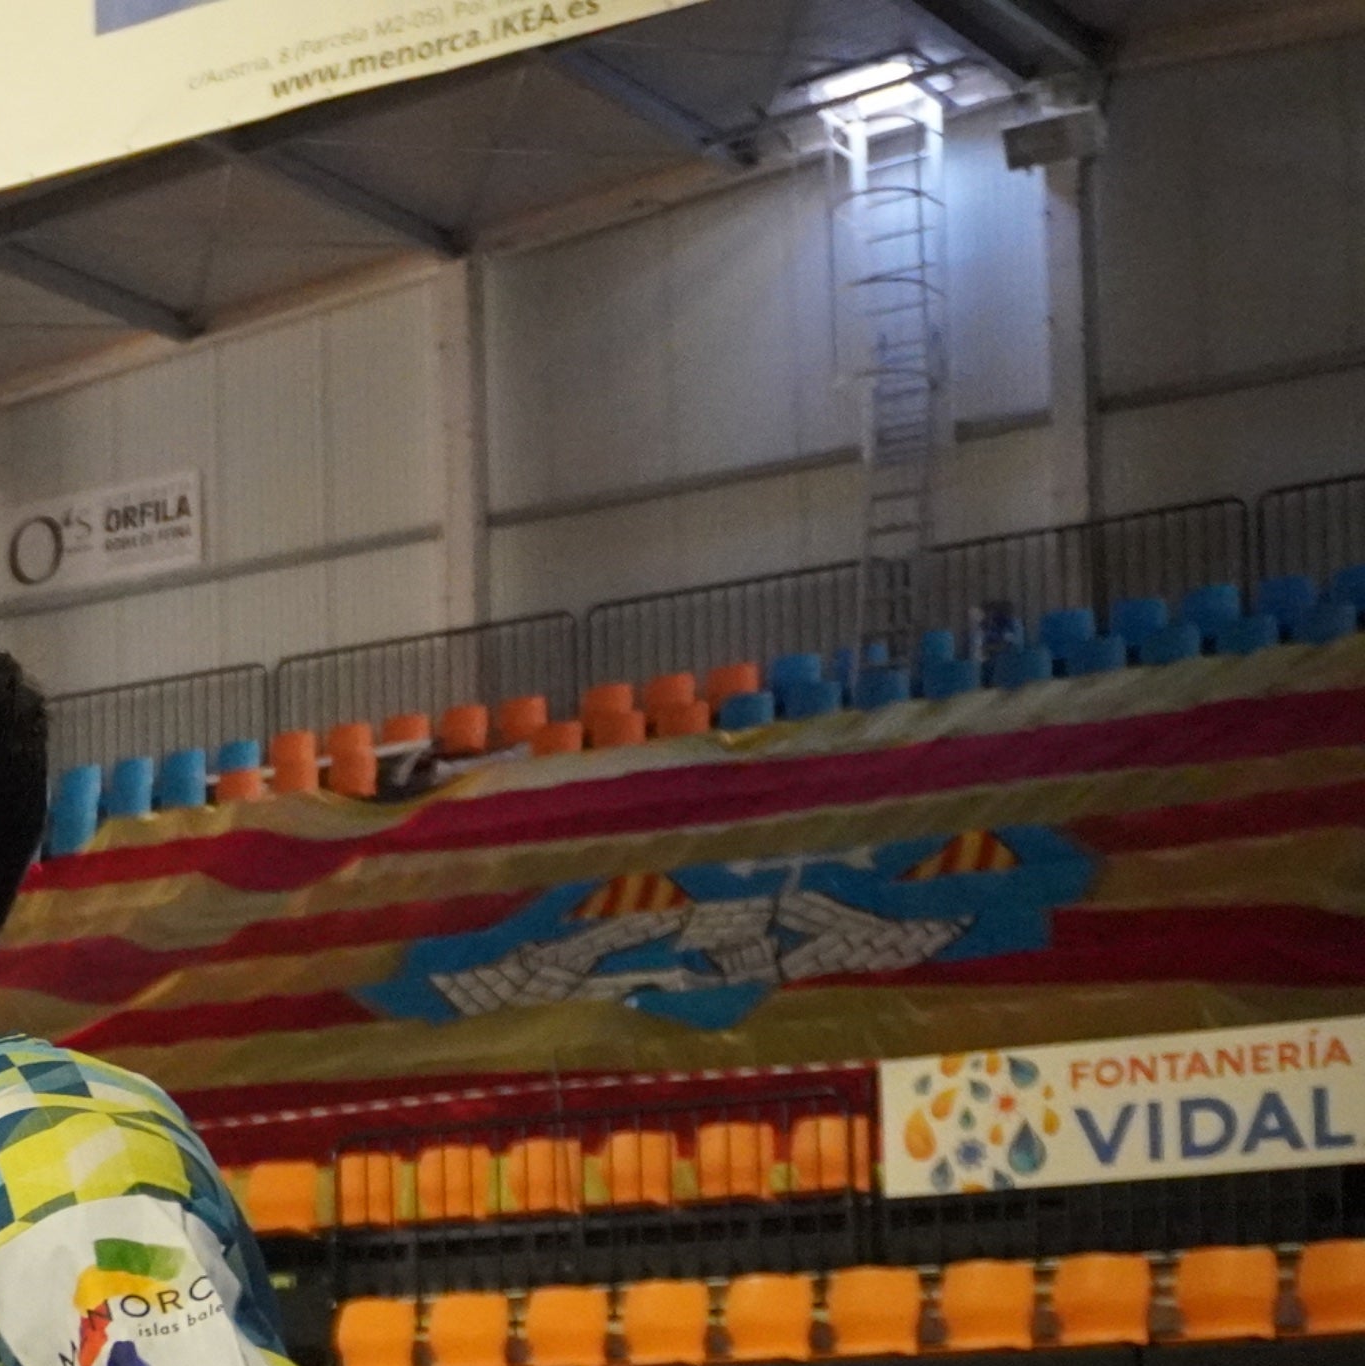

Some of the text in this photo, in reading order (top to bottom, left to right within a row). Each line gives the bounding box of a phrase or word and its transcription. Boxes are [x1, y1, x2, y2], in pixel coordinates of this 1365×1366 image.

[272, 0, 600, 98] www.menorca.IKEA.es
[105, 494, 191, 534] ORFILA
[1070, 1028, 1353, 1090] FONTANERÍA
[1074, 1087, 1357, 1166] VIDAL
[138, 1323, 180, 1338] islas
